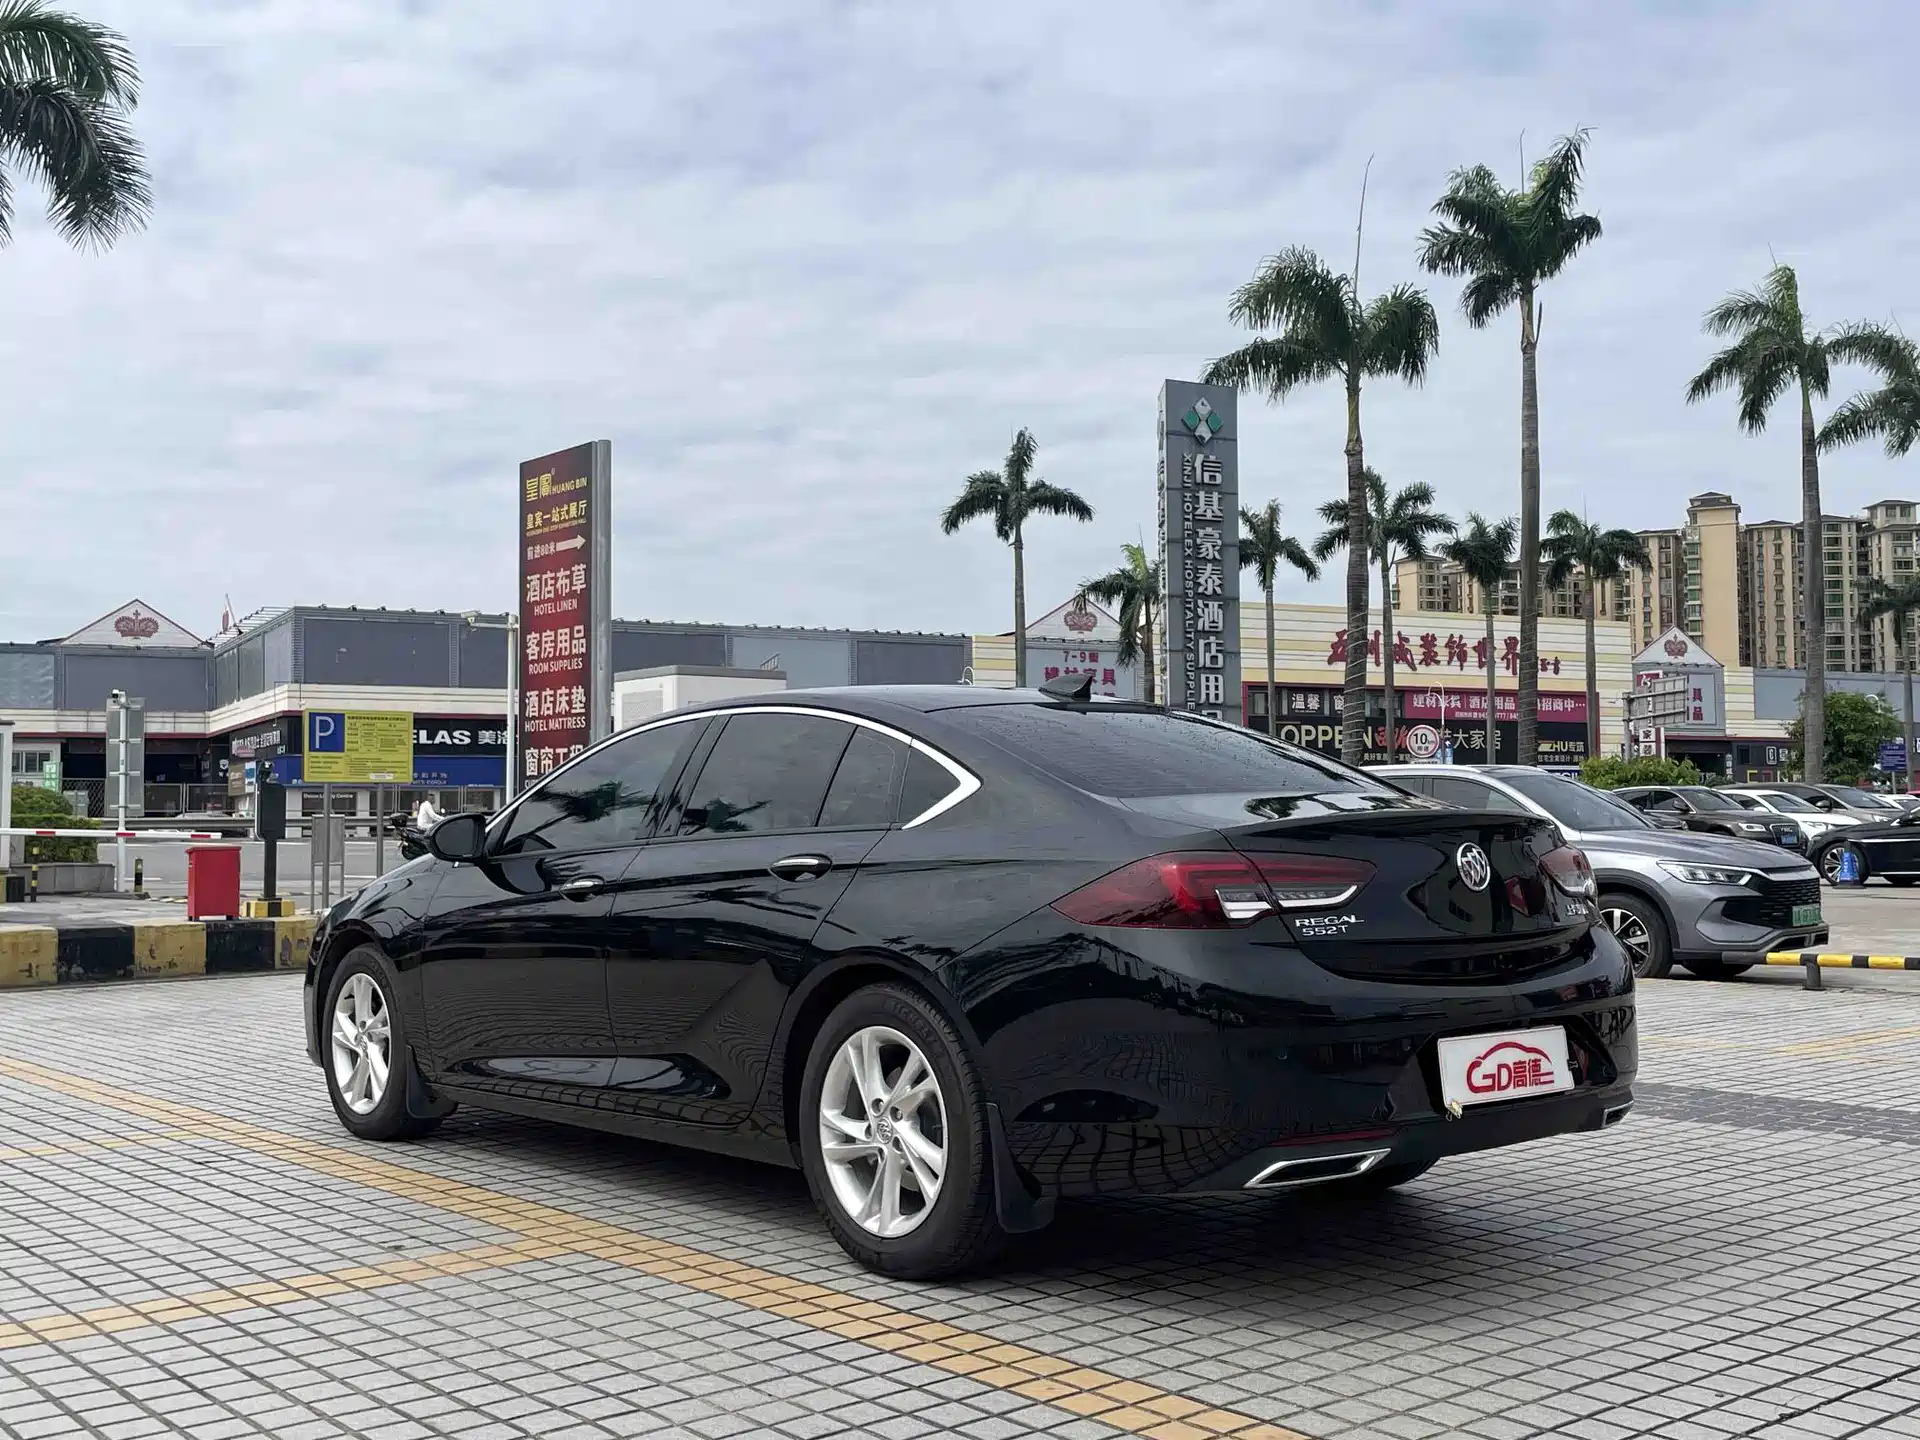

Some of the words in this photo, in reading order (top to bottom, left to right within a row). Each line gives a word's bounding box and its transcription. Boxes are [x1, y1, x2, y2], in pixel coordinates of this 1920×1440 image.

[1183, 452, 1193, 488] XINJI
[552, 480, 575, 494] HUANG
[526, 500, 587, 530] 皇宾一站式展厅
[1184, 493, 1194, 556] HOTELEX
[526, 563, 587, 602] 酒店布草
[534, 602, 556, 616] HOTEL
[557, 598, 578, 612] LINEN
[1185, 560, 1196, 650] HOSPITALITY
[526, 624, 586, 660] 客房用品
[528, 661, 549, 675] ROOM
[549, 657, 583, 672] SUPPLIES
[525, 685, 586, 718] 酒店床垫
[1291, 693, 1320, 710] 温馨
[315, 715, 335, 749] P
[524, 719, 548, 733] HOTEL
[549, 716, 586, 730] MATTRESS
[1280, 725, 1373, 750] OPPEN
[1295, 914, 1365, 927] REGAL
[1302, 925, 1348, 936] 552T
